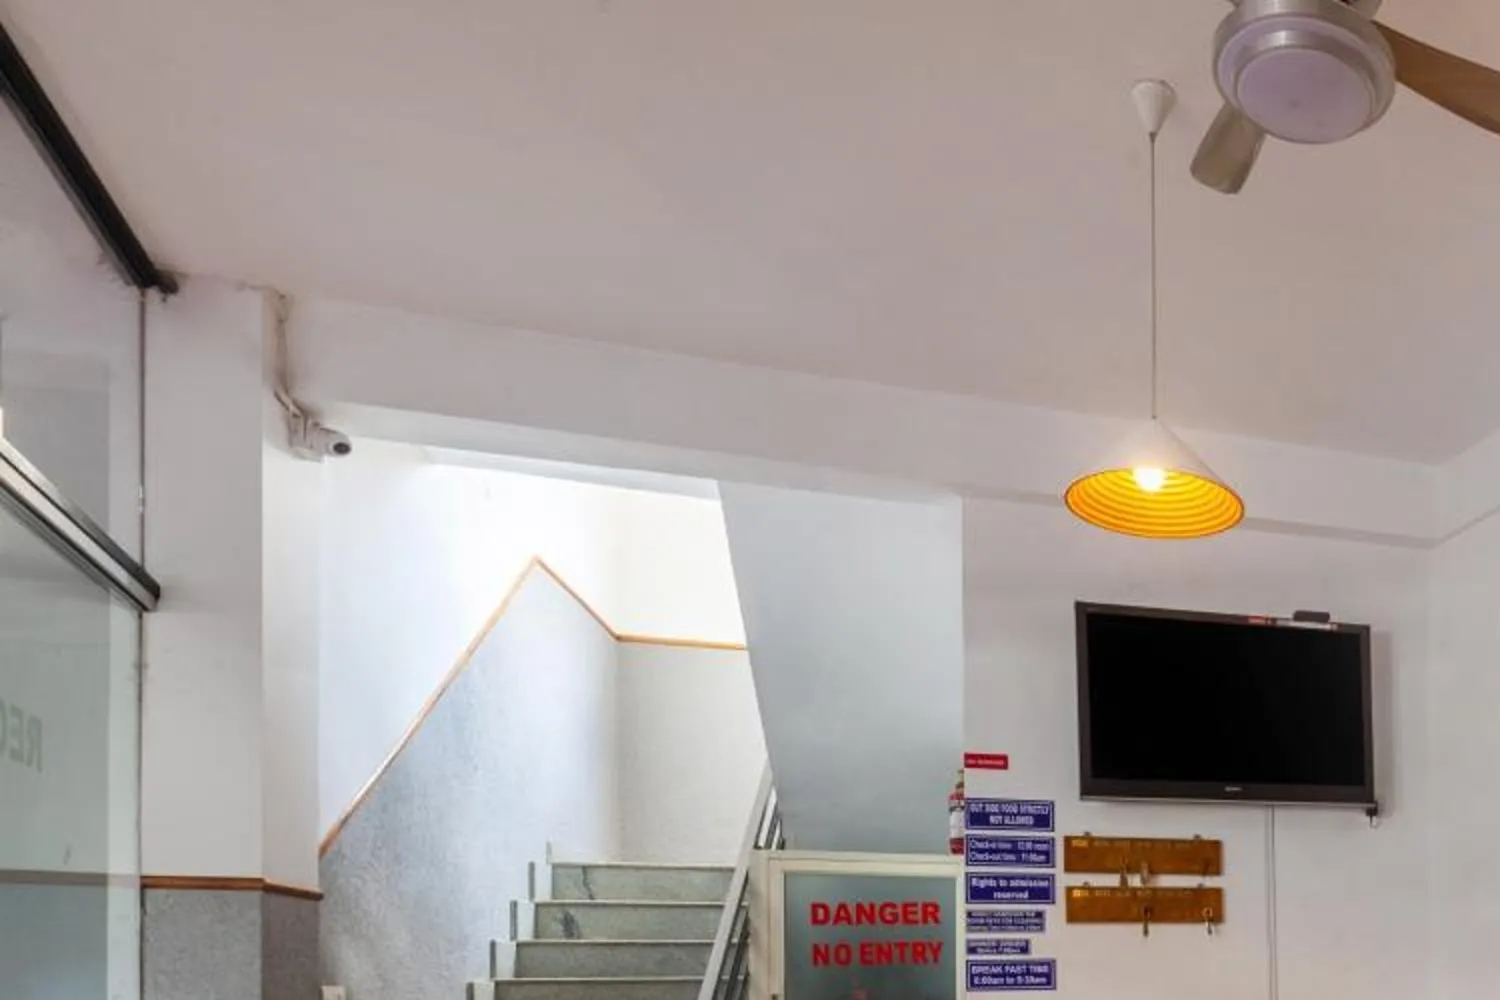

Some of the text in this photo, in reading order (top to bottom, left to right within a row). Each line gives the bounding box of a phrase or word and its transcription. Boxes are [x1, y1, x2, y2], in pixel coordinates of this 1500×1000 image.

[971, 878, 997, 889] Rights
[811, 902, 942, 926] DANGER
[812, 941, 944, 967] NO ENTRY
